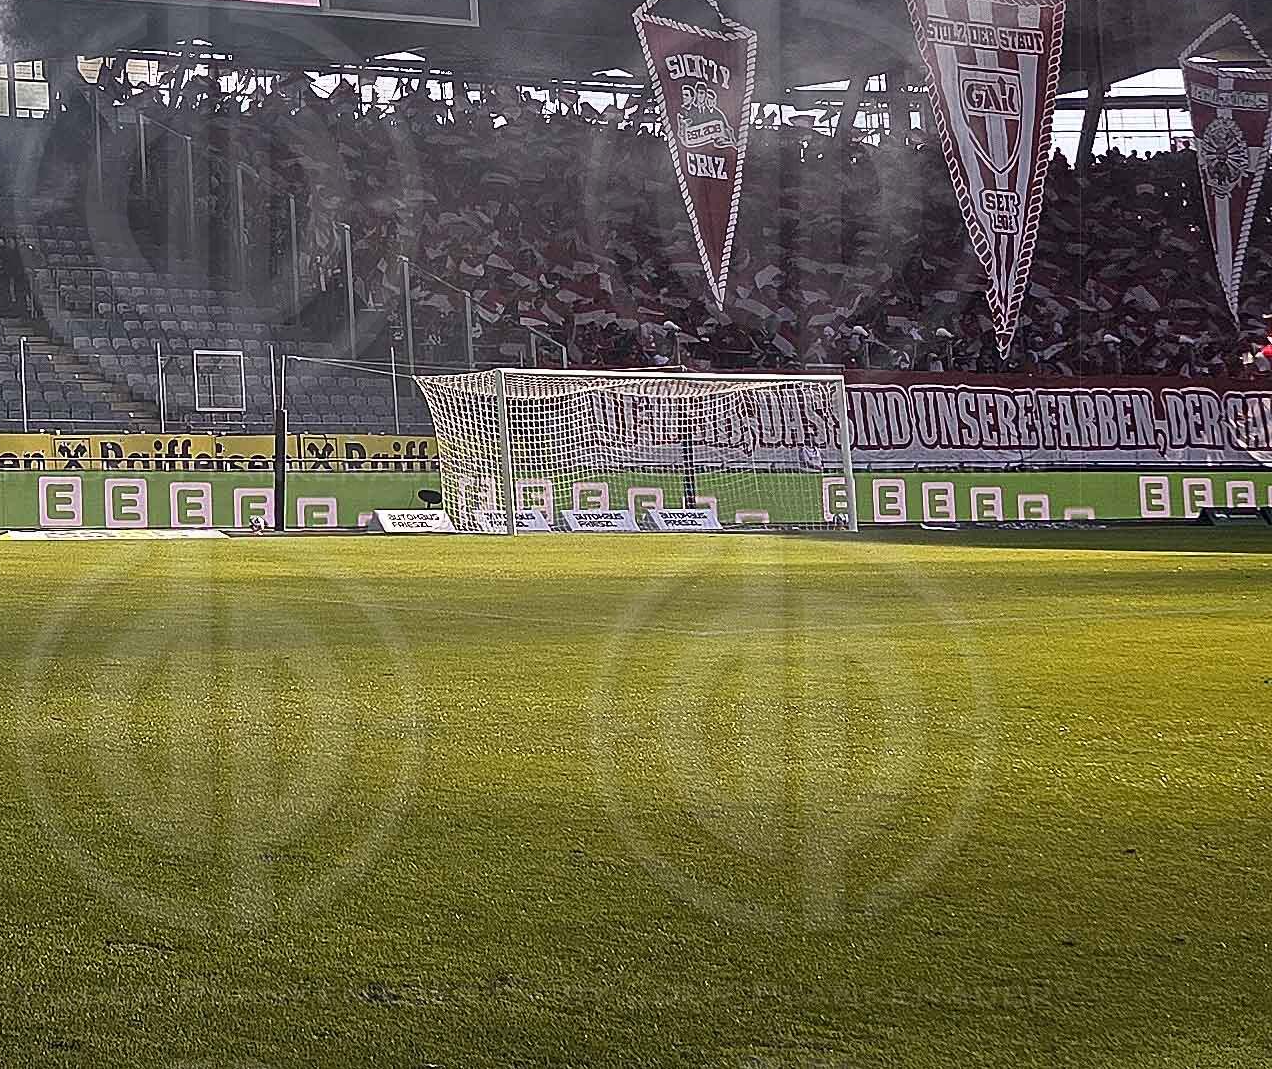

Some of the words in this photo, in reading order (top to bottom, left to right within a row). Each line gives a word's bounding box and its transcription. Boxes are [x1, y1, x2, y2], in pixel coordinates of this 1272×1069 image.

[969, 25, 997, 46] DER
[998, 30, 1045, 54] STADT
[686, 151, 729, 180] GRAZ
[913, 392, 1039, 448] UNSERE
[1041, 392, 1166, 456] FARBEN,
[1166, 394, 1224, 446] DER
[1226, 396, 1271, 449] GA
